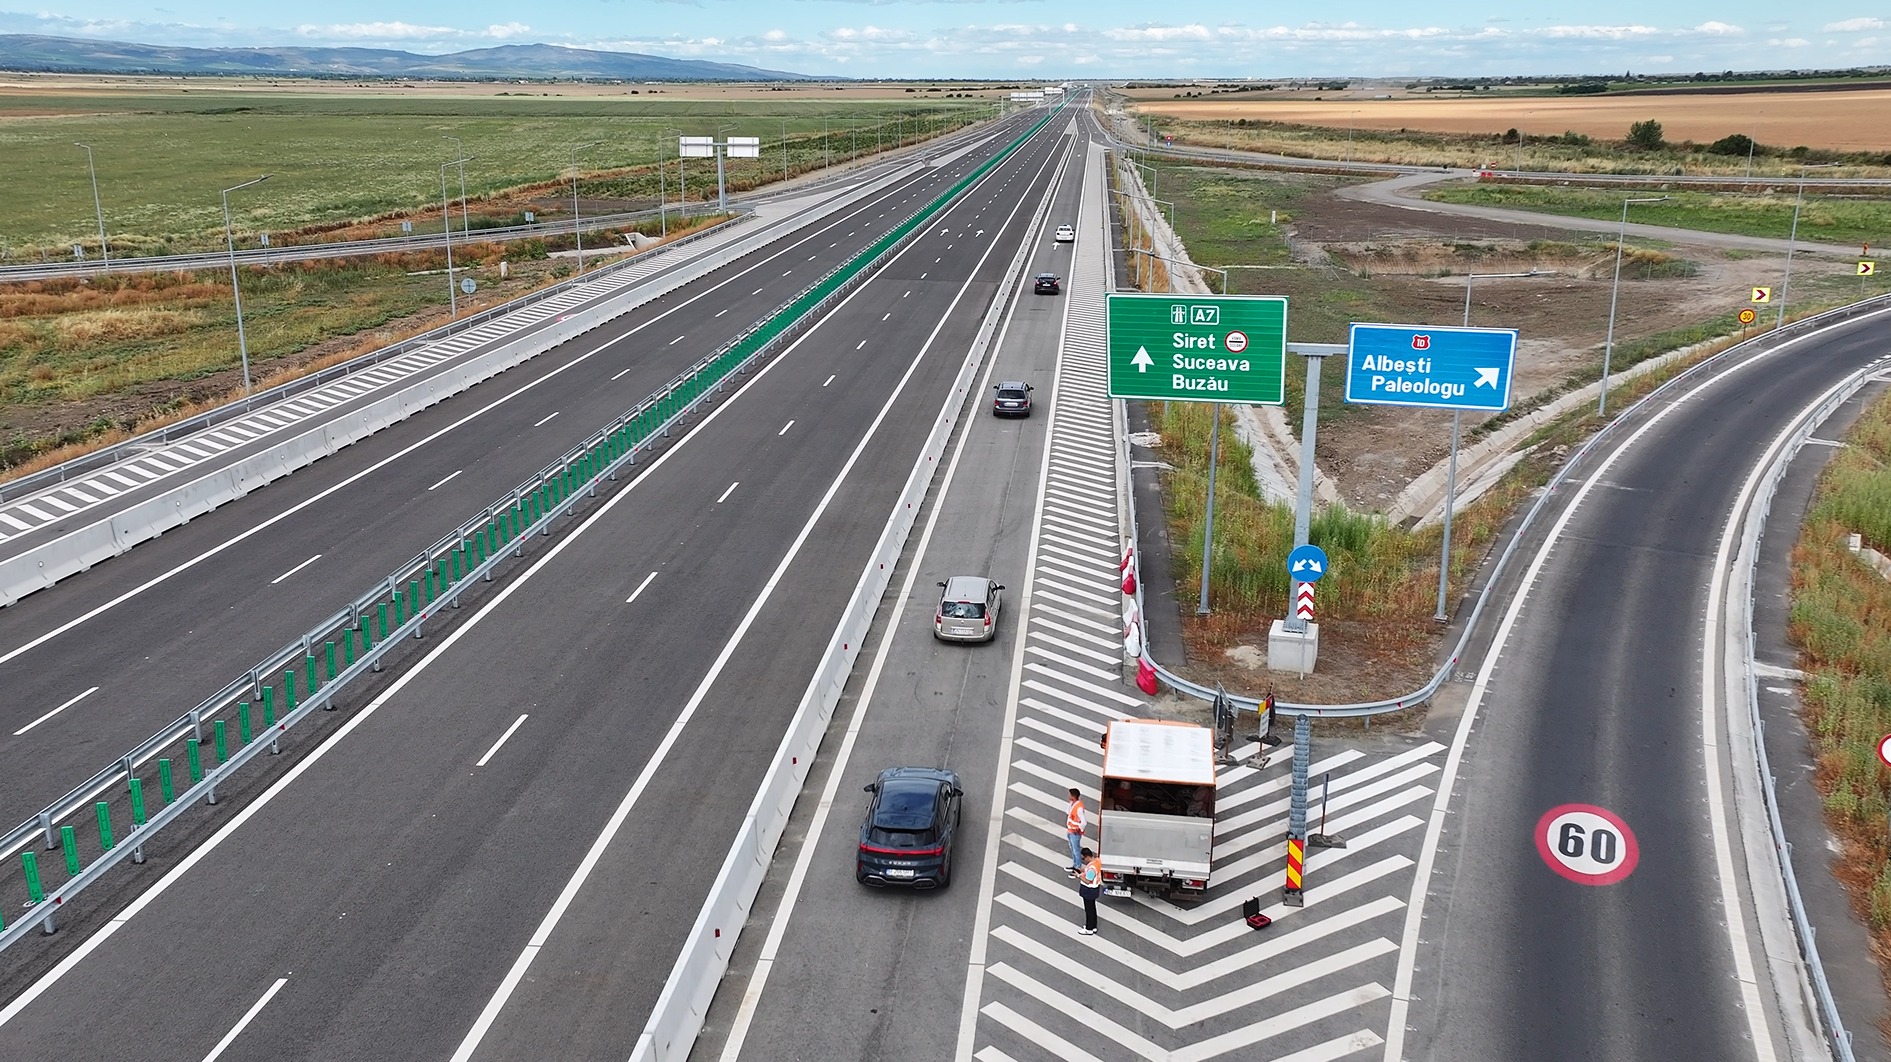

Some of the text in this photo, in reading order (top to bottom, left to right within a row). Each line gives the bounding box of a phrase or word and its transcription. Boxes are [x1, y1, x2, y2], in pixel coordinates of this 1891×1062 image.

[1195, 309, 1215, 322] A7
[1172, 333, 1216, 349] Siret
[1417, 338, 1426, 348] 10
[1172, 354, 1250, 371] Suceava
[1361, 354, 1431, 375] Albești
[1172, 374, 1229, 391] Buzău
[1371, 375, 1465, 399] Paleologu
[1558, 823, 1616, 864] 60
